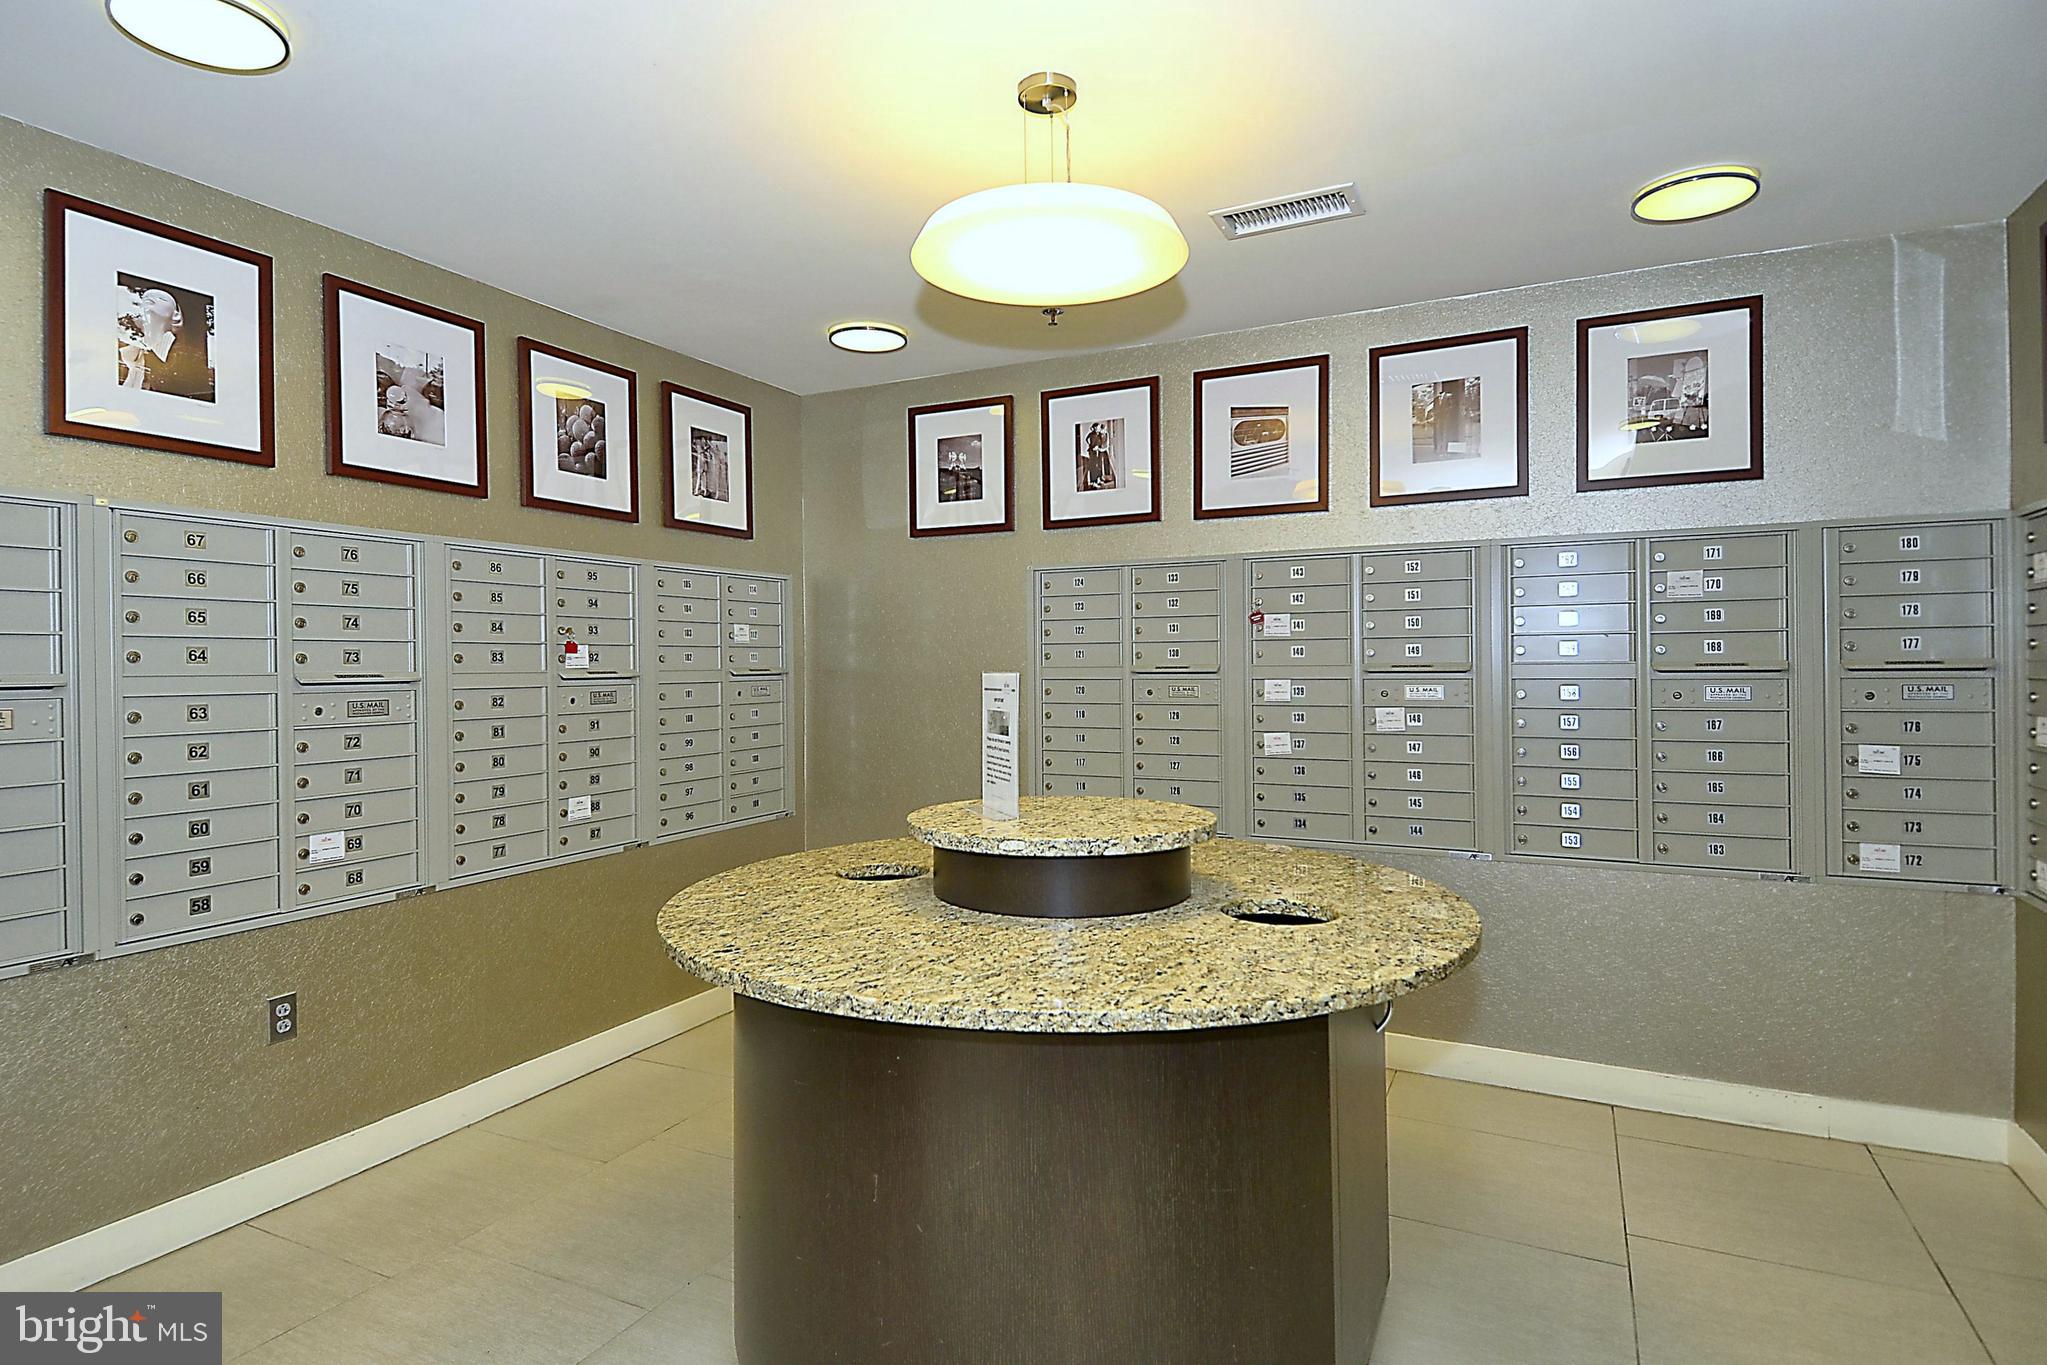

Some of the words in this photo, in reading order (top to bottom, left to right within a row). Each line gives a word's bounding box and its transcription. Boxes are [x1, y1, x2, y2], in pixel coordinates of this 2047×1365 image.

[187, 533, 205, 547] 67
[1901, 537, 1918, 549] 180
[343, 548, 357, 561] 76
[1705, 547, 1721, 558] 171
[490, 563, 501, 573] 86
[1292, 567, 1304, 577] 143
[1406, 562, 1419, 572] 152
[187, 571, 205, 585] 66
[588, 572, 597, 581] 95
[1168, 573, 1178, 582] 133
[1901, 571, 1918, 582] 179
[1074, 578, 1084, 587] 124
[1706, 578, 1721, 589] 170
[343, 582, 358, 595] 75
[491, 593, 502, 602] 85
[1292, 594, 1304, 604] 142
[1407, 589, 1420, 600] 151
[588, 599, 598, 608] 94
[1075, 602, 1084, 611] 123
[1168, 599, 1179, 607] 132
[1901, 604, 1919, 616] 178
[188, 610, 205, 624] 65
[1706, 610, 1721, 621] 169
[344, 616, 359, 629] 74
[491, 622, 503, 632] 84
[1292, 619, 1304, 630] 141
[1408, 618, 1420, 628] 150
[588, 626, 598, 635] 93
[1075, 626, 1084, 635] 122
[1169, 624, 1179, 632] 131
[1706, 641, 1722, 652] 168
[1902, 637, 1919, 649] 177
[188, 648, 207, 662] 64
[1075, 650, 1085, 658] 121
[1169, 649, 1179, 658] 130
[1292, 647, 1304, 657] 140
[1408, 646, 1420, 656] 149
[344, 650, 359, 664] 73
[492, 652, 503, 662] 83
[589, 653, 599, 663] 92
[1293, 686, 1304, 696] 139
[492, 697, 504, 707] 82
[189, 707, 207, 721] 63
[1293, 713, 1305, 723] 138
[1408, 714, 1421, 724] 148
[590, 720, 600, 730] 91
[1563, 717, 1576, 727] 157
[1707, 719, 1722, 730] 167
[1903, 721, 1921, 733] 176
[493, 727, 504, 738] 81
[345, 735, 361, 749] 72
[685, 739, 693, 747] 99
[1293, 739, 1305, 749] 137
[1408, 742, 1421, 752] 147
[189, 744, 207, 759] 62
[590, 748, 600, 757] 90
[1563, 747, 1577, 756] 156
[1707, 751, 1723, 762] 166
[493, 756, 504, 767] 80
[1076, 758, 1086, 767] 117
[1170, 761, 1180, 770] 127
[1903, 755, 1921, 766] 175
[685, 763, 693, 771] 98
[346, 769, 361, 783] 71
[590, 775, 600, 784] 89
[1408, 770, 1421, 780] 146
[1563, 776, 1577, 786] 155
[191, 784, 209, 798] 61
[493, 786, 504, 797] 79
[685, 788, 693, 796] 97
[1707, 782, 1723, 793] 165
[1294, 792, 1306, 802] 135
[1904, 788, 1921, 799] 174
[590, 800, 600, 812] 88
[1409, 798, 1422, 808] 145
[346, 804, 361, 817] 70
[1564, 806, 1578, 816] 154
[493, 814, 505, 826] 78
[685, 812, 693, 820] 96
[1708, 813, 1724, 824] 164
[191, 821, 209, 835] 60
[1294, 818, 1306, 828] 134
[1904, 821, 1922, 833] 173
[590, 828, 600, 838] 87
[1410, 826, 1422, 836] 144
[347, 837, 362, 850] 69
[1564, 835, 1578, 845] 153
[493, 844, 505, 855] 77
[1709, 844, 1724, 855] 163
[1905, 855, 1922, 866] 172
[191, 860, 209, 874] 59
[347, 871, 363, 884] 68
[191, 898, 209, 912] 58
